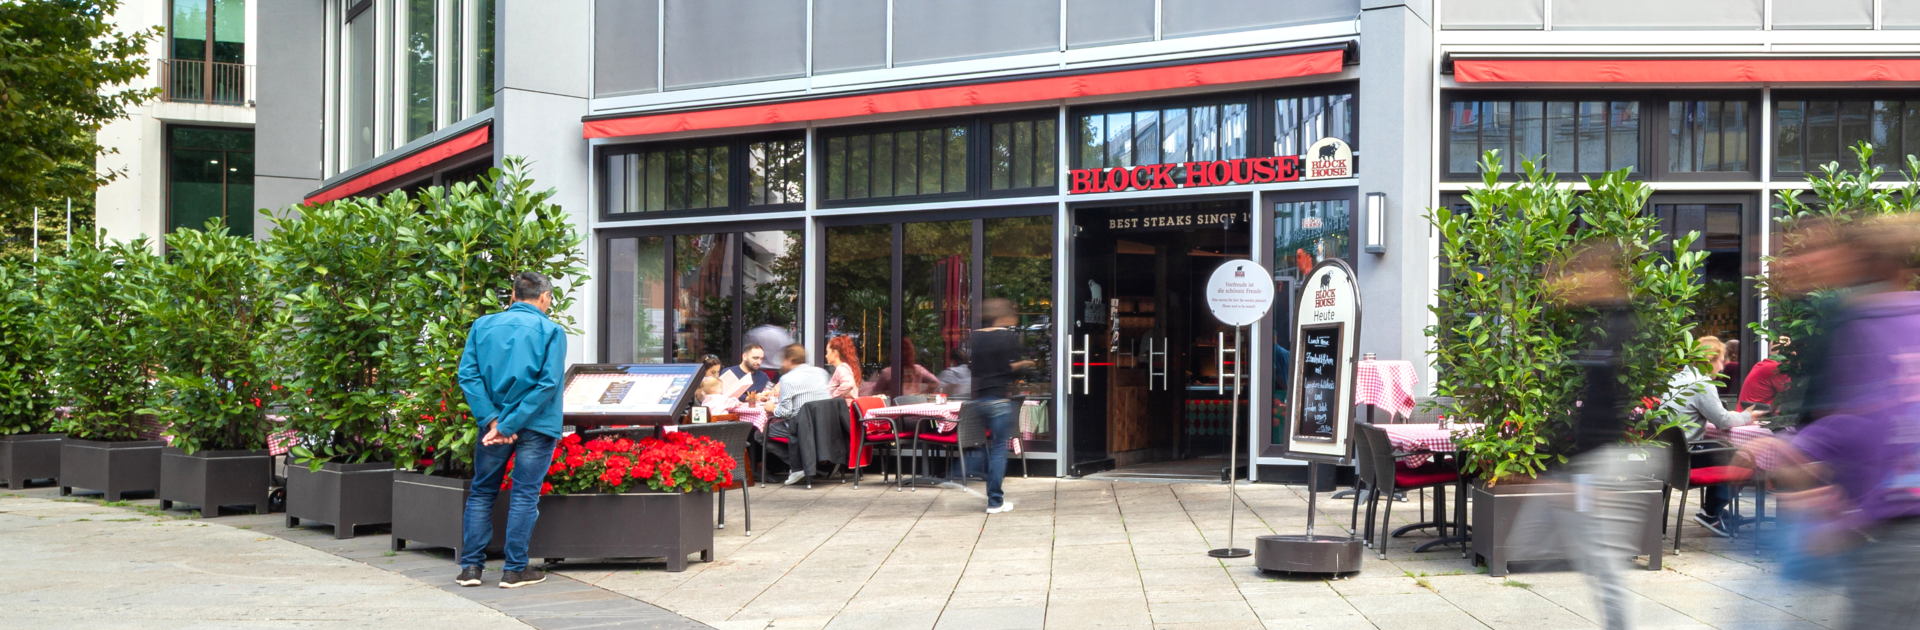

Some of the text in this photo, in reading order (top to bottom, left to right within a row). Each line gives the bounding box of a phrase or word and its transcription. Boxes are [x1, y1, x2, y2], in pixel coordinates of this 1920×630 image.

[1311, 159, 1346, 169] BLOCK
[1069, 155, 1299, 194] BLOCK HOUSE
[1311, 168, 1347, 178] HOUSE
[1109, 218, 1138, 229] BEST
[1143, 215, 1192, 227] STEAKS
[1315, 289, 1336, 299] BLOCK
[1315, 298, 1335, 308] HOUSE
[1314, 309, 1335, 322] Heute
